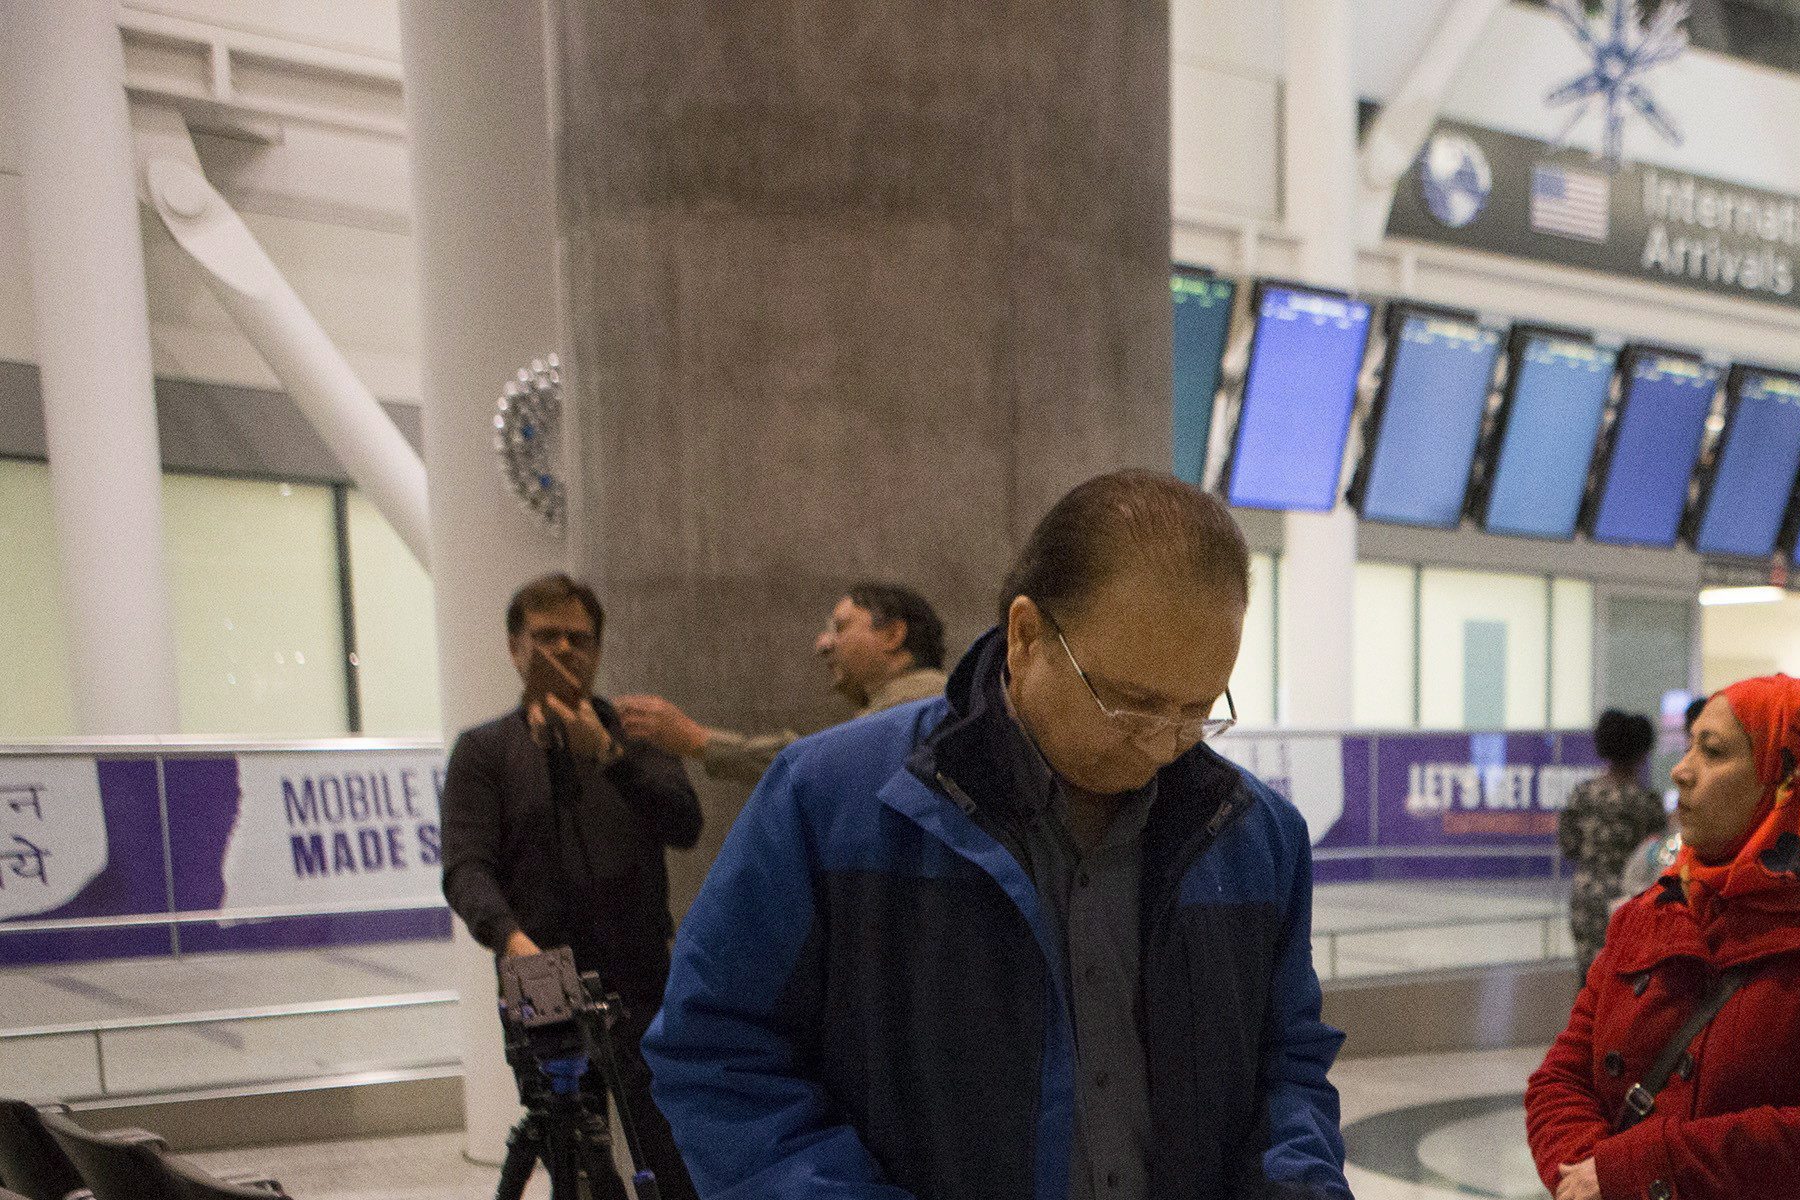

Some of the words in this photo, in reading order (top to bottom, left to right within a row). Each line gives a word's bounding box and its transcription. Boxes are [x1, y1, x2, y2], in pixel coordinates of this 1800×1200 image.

[1641, 222, 1795, 298] Arrivals
[282, 765, 421, 826] MOBILE
[290, 823, 407, 879] MADE
